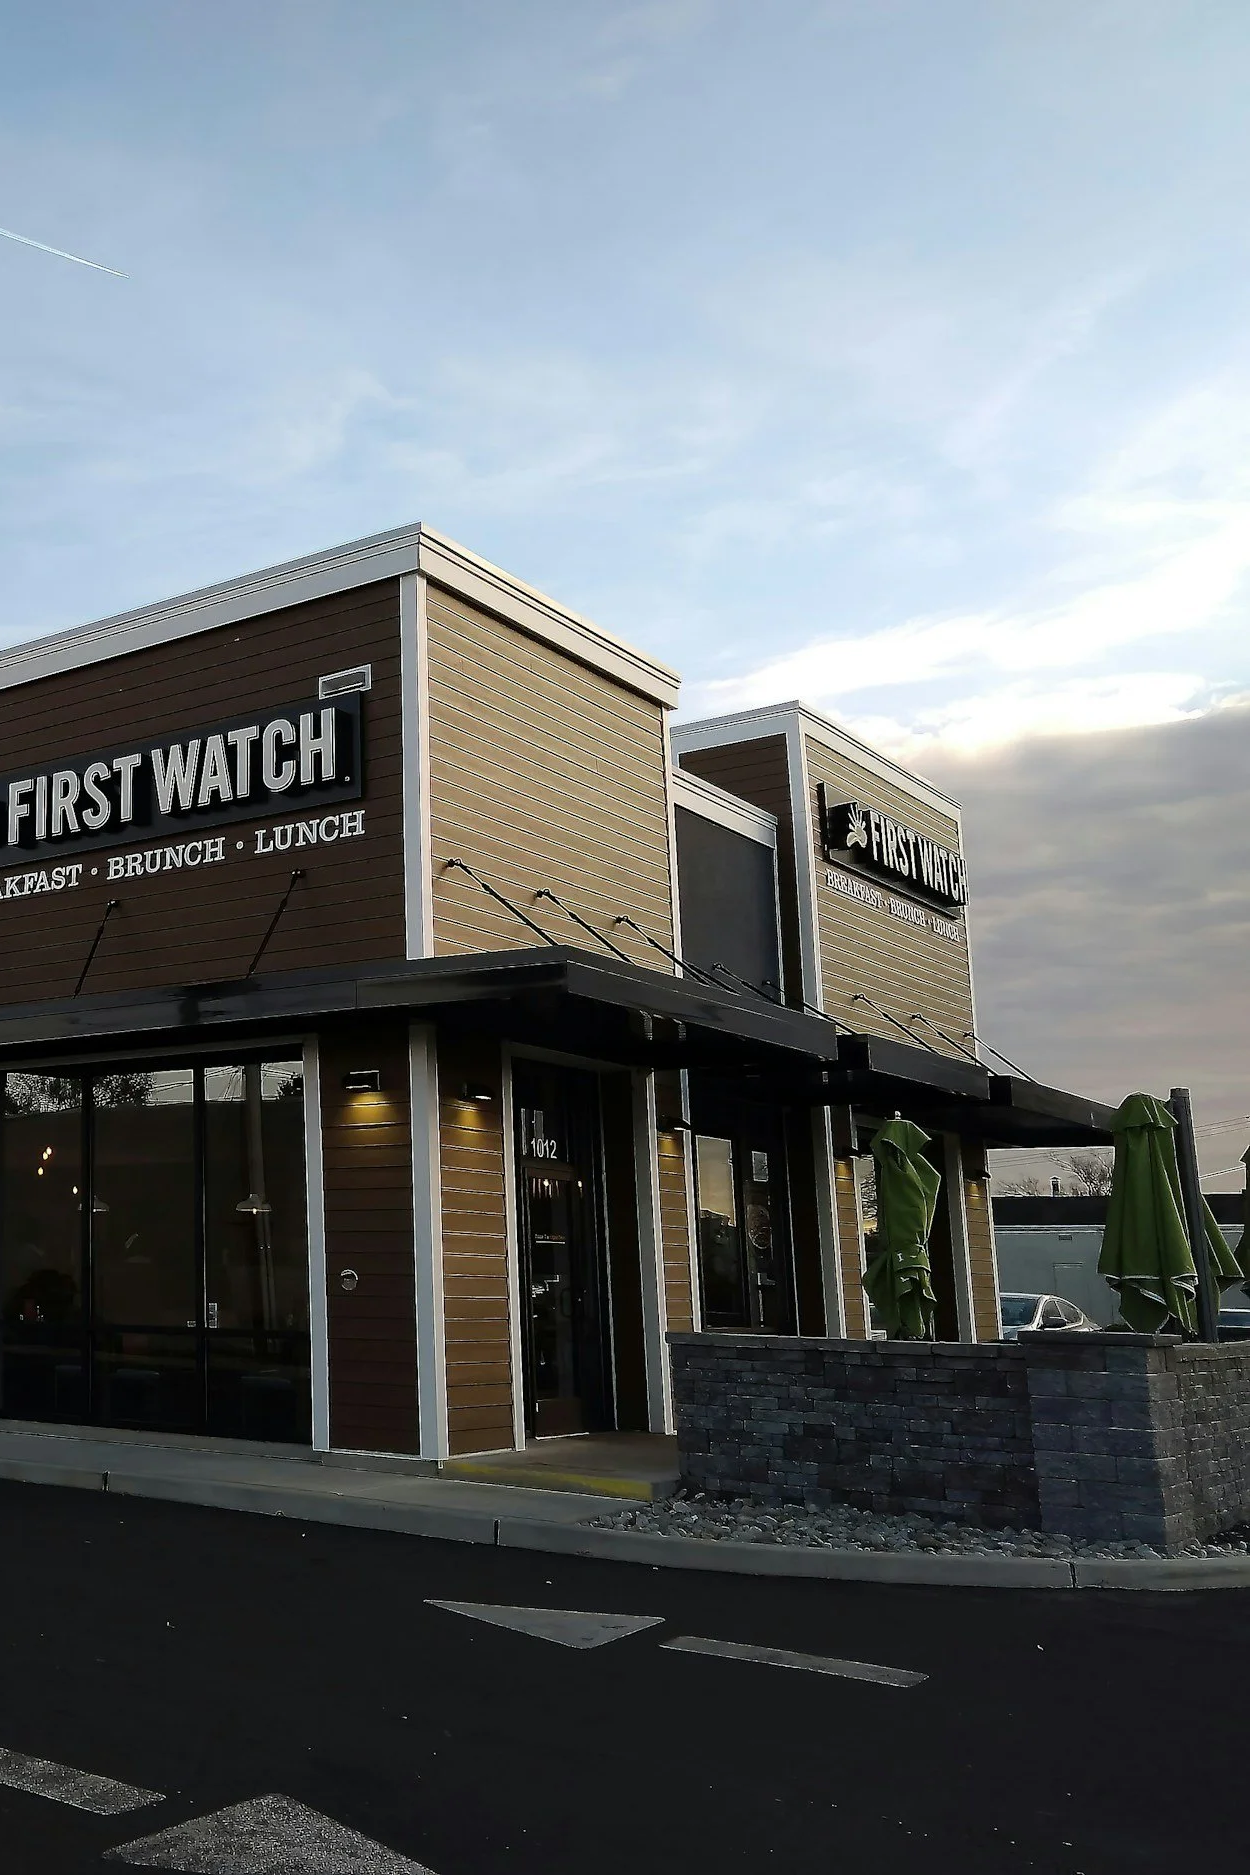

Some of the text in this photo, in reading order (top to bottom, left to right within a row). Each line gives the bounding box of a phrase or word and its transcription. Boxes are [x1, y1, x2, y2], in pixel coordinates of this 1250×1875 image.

[7, 707, 336, 846] FIRST WATCH
[106, 836, 226, 881] BRUNCH
[254, 809, 366, 854] LUNCH
[869, 809, 970, 904] FIRST WATCH
[825, 868, 882, 909] BREAKFAST
[530, 1137, 557, 1159] 1012
